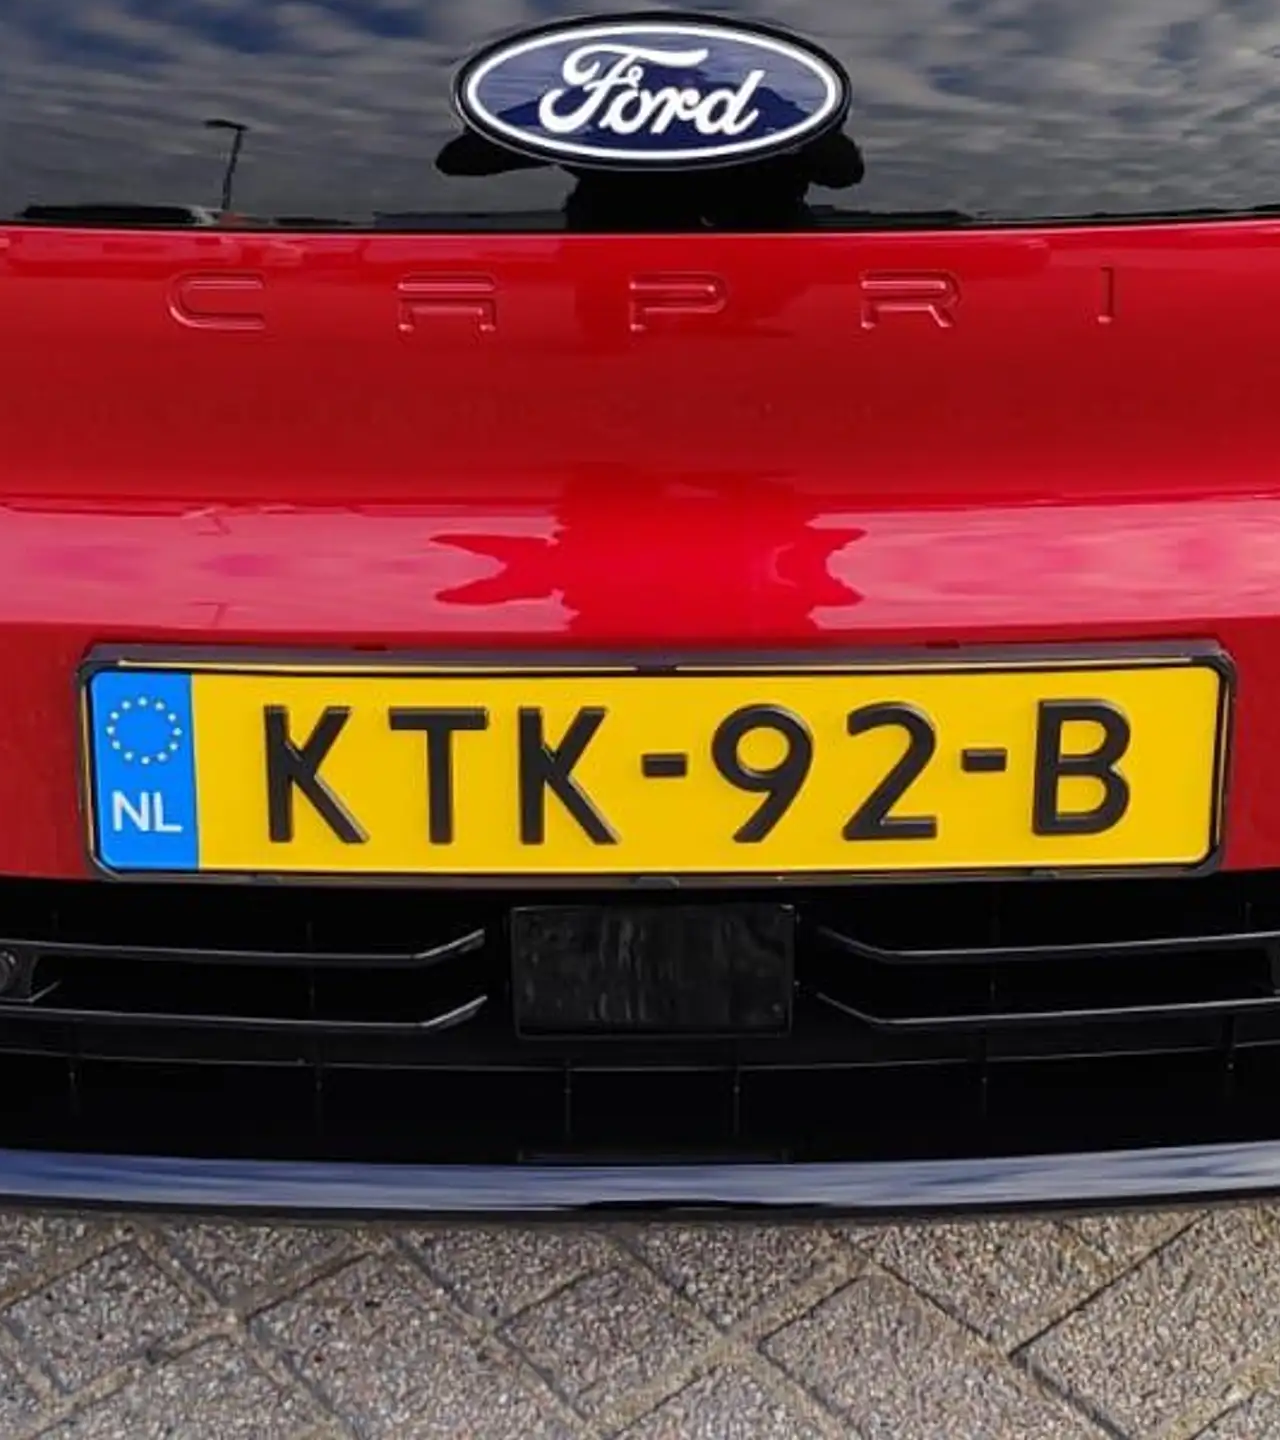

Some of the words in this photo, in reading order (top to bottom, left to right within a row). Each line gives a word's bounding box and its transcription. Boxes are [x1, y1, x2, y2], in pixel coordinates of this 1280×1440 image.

[539, 43, 766, 135] Ford
[165, 266, 1115, 332] CAPRI
[111, 790, 183, 833] NL
[263, 698, 1131, 846] KTK-92-B
